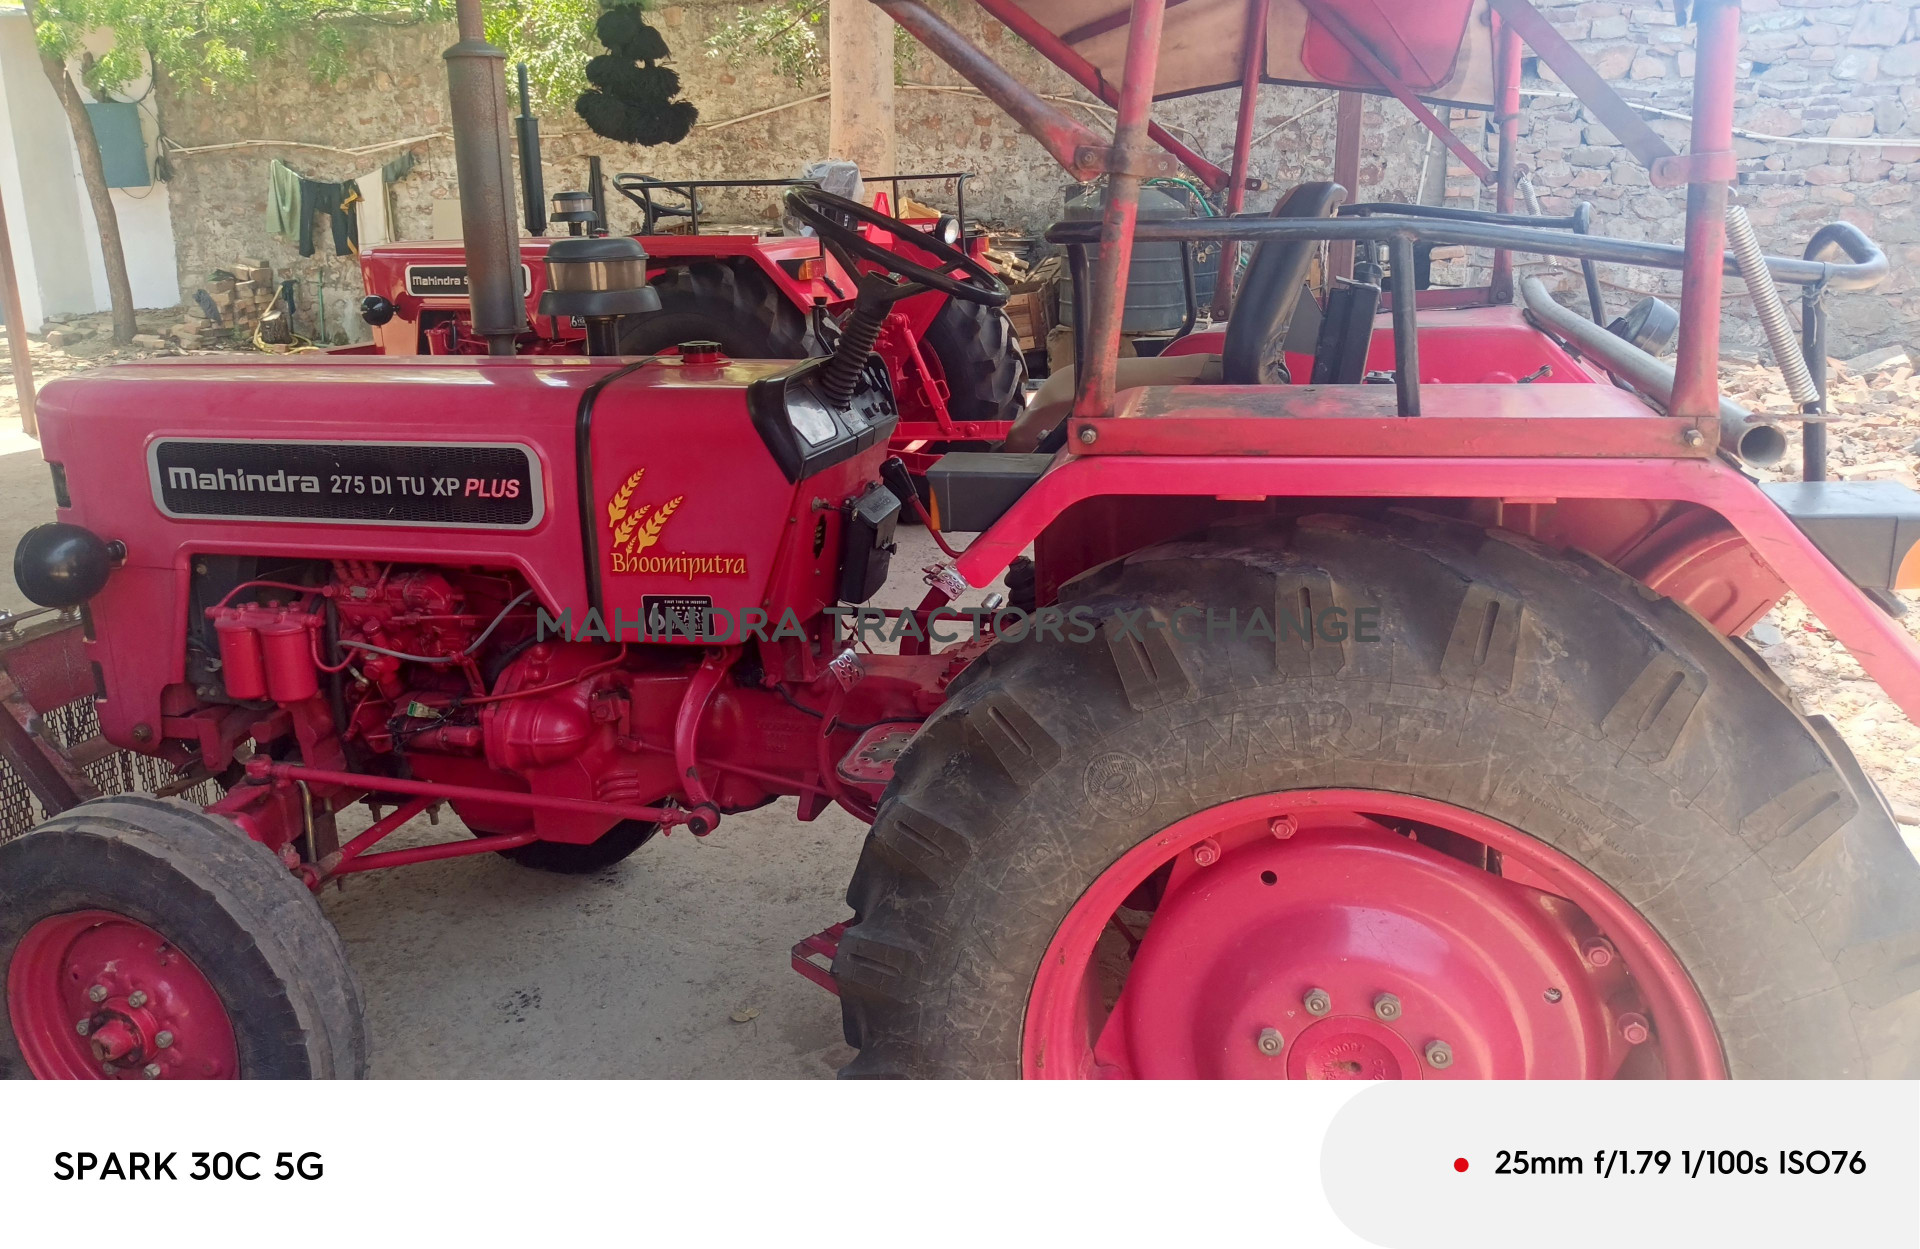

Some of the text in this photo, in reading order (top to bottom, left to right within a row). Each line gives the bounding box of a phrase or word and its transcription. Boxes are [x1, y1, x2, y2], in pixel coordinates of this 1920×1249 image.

[412, 276, 461, 286] Mahindra
[571, 315, 578, 328] 6
[168, 467, 520, 498] Mahindra 275 DI TU XP PLUS
[610, 550, 746, 581] Bhoomiputra
